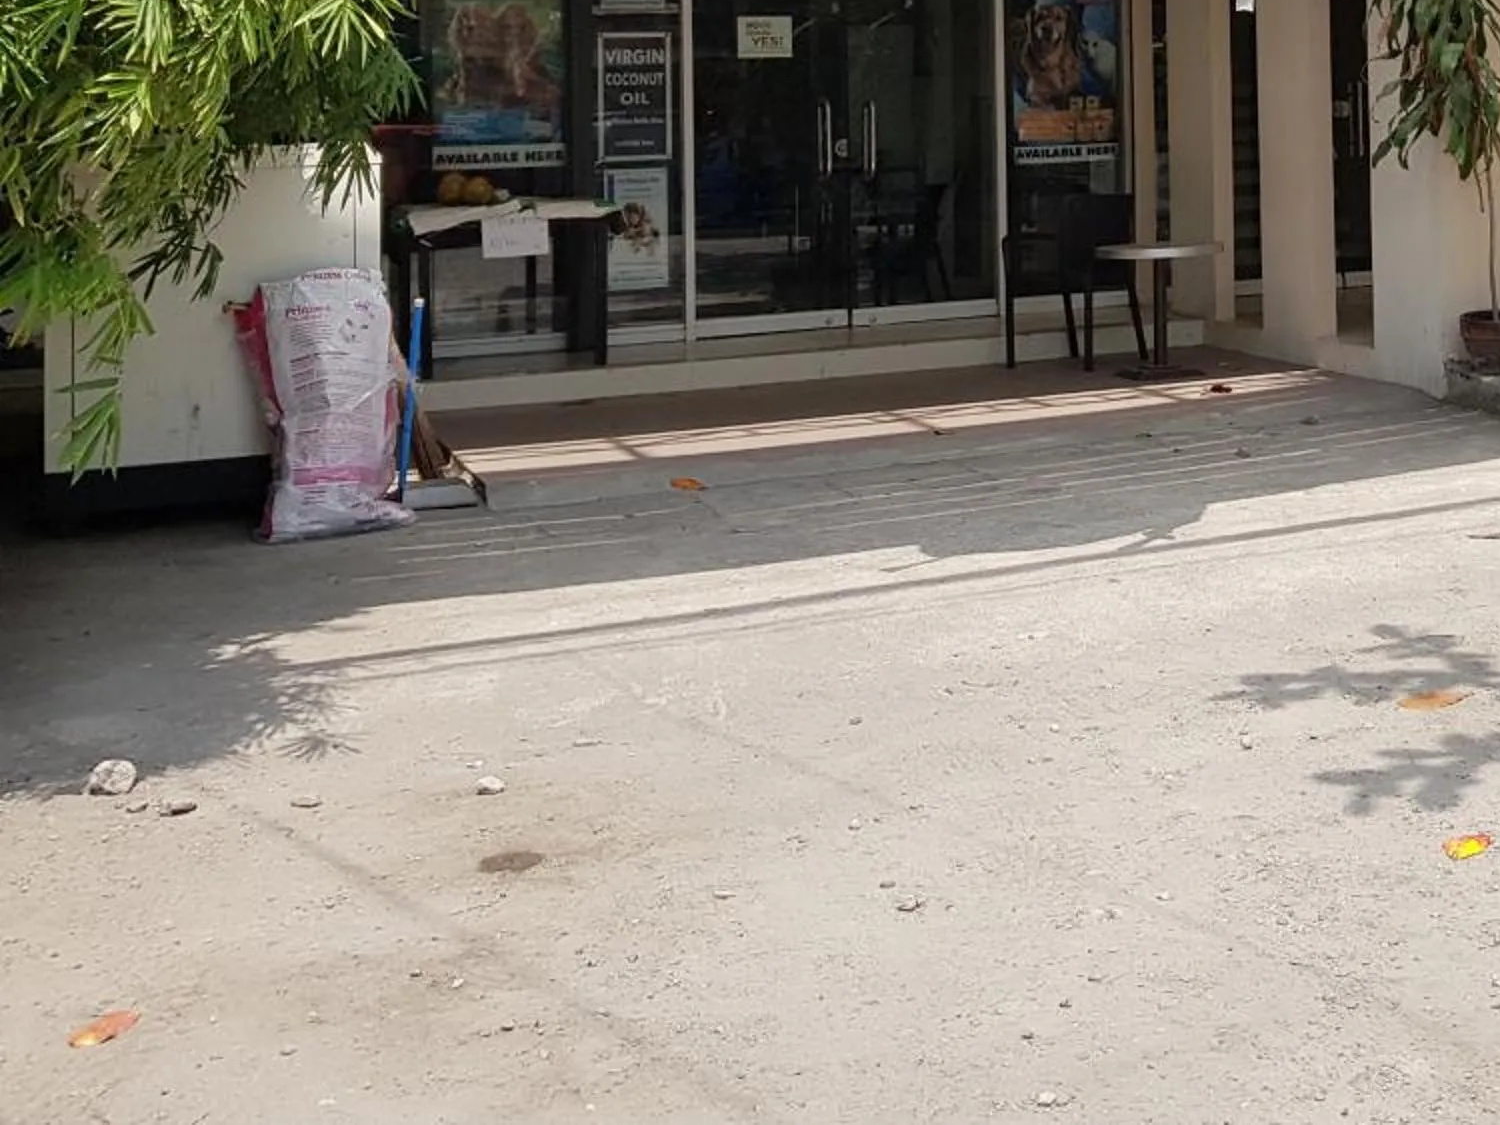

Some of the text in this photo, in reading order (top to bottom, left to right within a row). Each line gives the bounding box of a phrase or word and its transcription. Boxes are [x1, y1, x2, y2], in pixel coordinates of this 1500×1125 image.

[605, 49, 665, 66] VIRGIN
[605, 72, 665, 86] COCONUT
[620, 91, 651, 106] OIL
[435, 151, 519, 164] AVAILABLE
[1015, 147, 1081, 158] AVAILABLE
